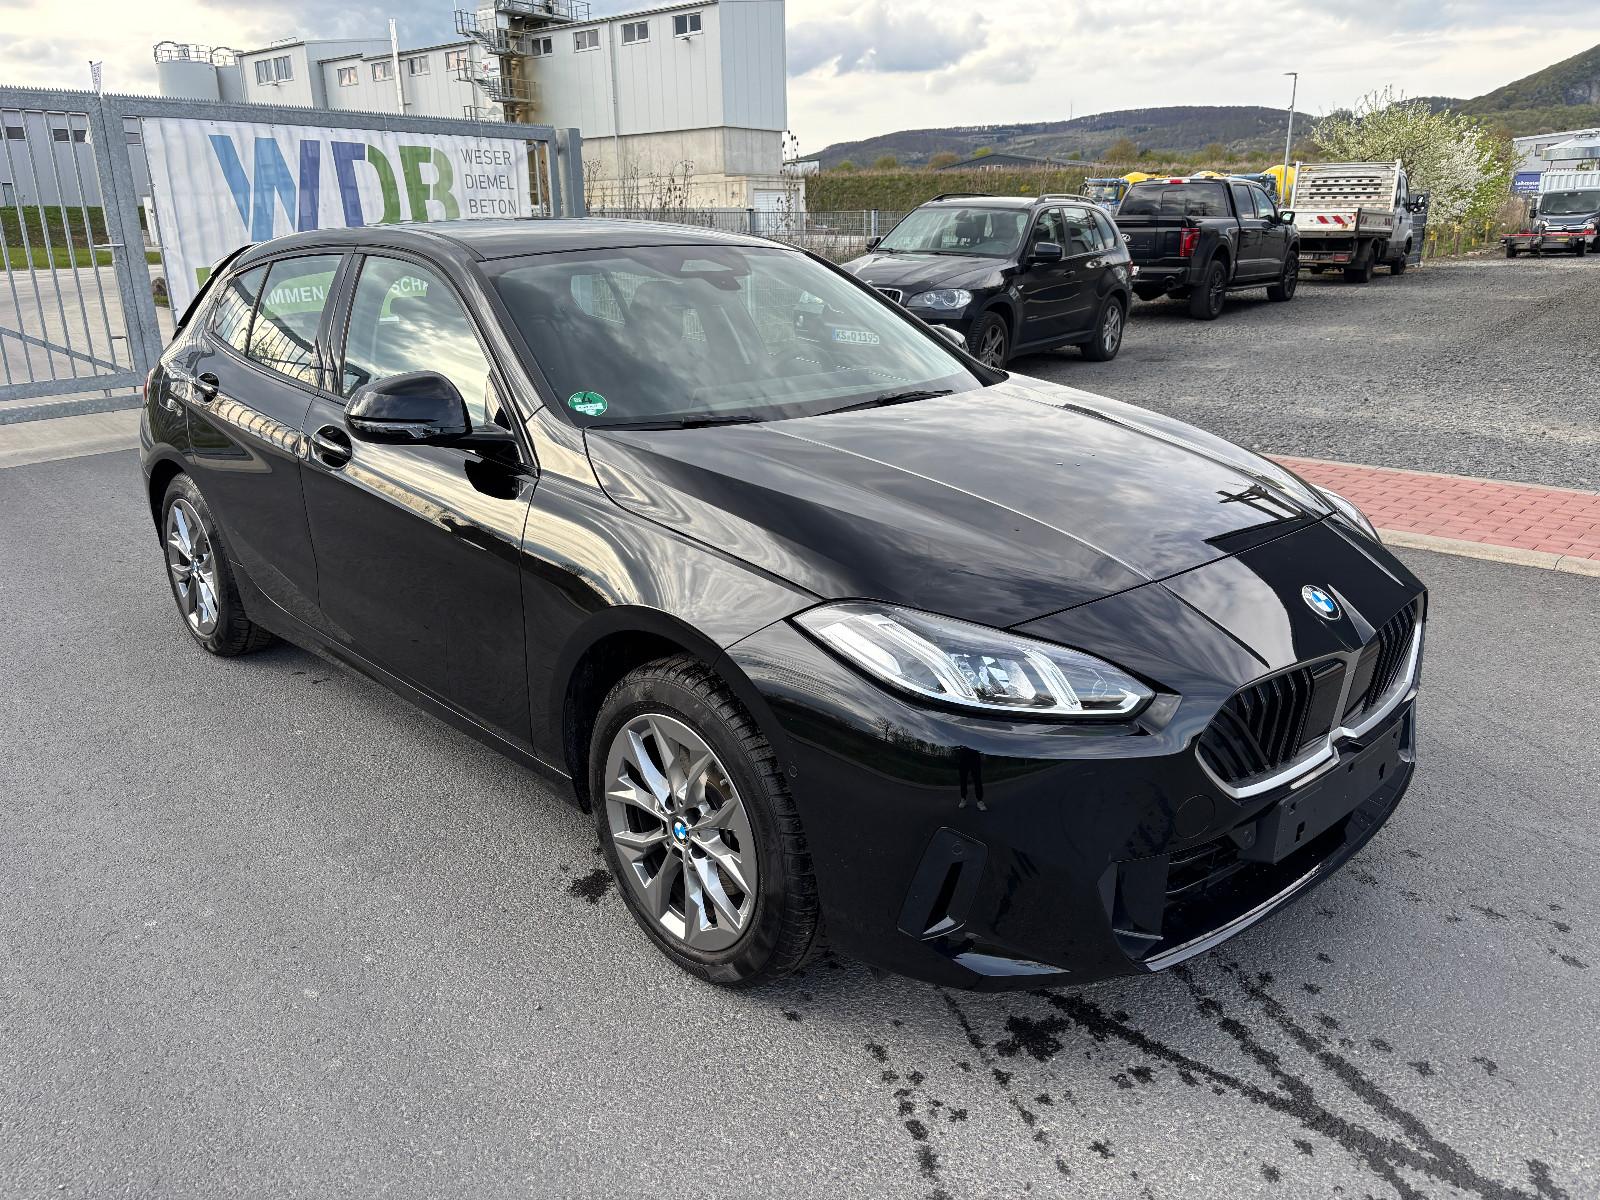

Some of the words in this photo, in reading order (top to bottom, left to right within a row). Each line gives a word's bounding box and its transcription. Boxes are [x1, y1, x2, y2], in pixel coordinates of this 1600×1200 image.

[460, 148, 512, 166] WESER
[208, 135, 460, 242] WDB
[465, 174, 515, 190] DIEMEL
[469, 198, 517, 214] BETON
